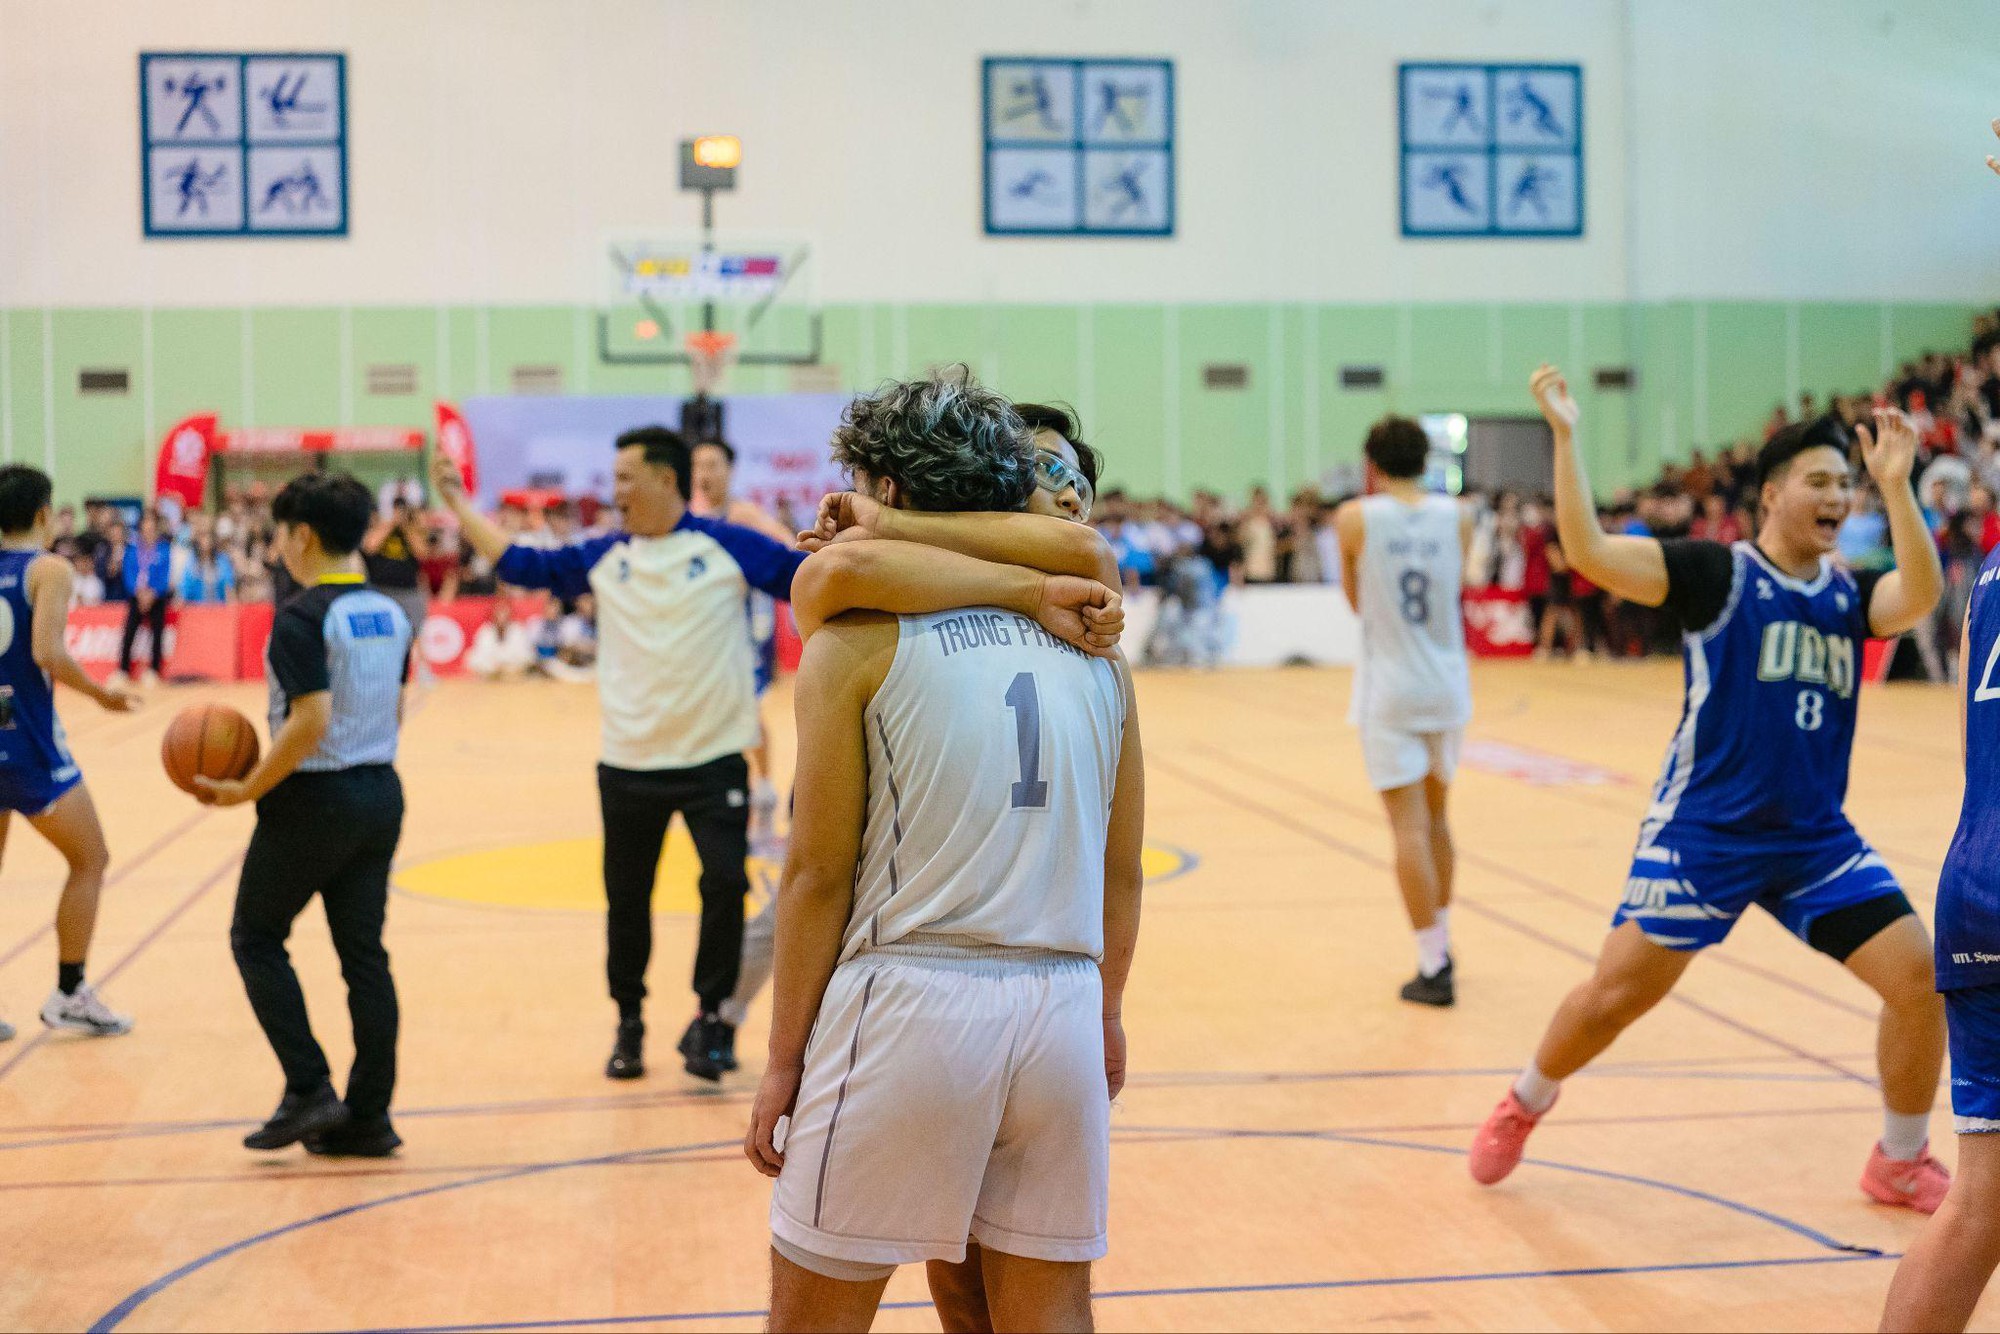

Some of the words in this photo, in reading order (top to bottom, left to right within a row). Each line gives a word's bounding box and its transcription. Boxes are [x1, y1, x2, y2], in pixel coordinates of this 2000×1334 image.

[1401, 570, 1429, 624] 8
[932, 614, 1012, 657] TRUNG
[1795, 690, 1824, 731] 8
[1005, 672, 1047, 808] 1
